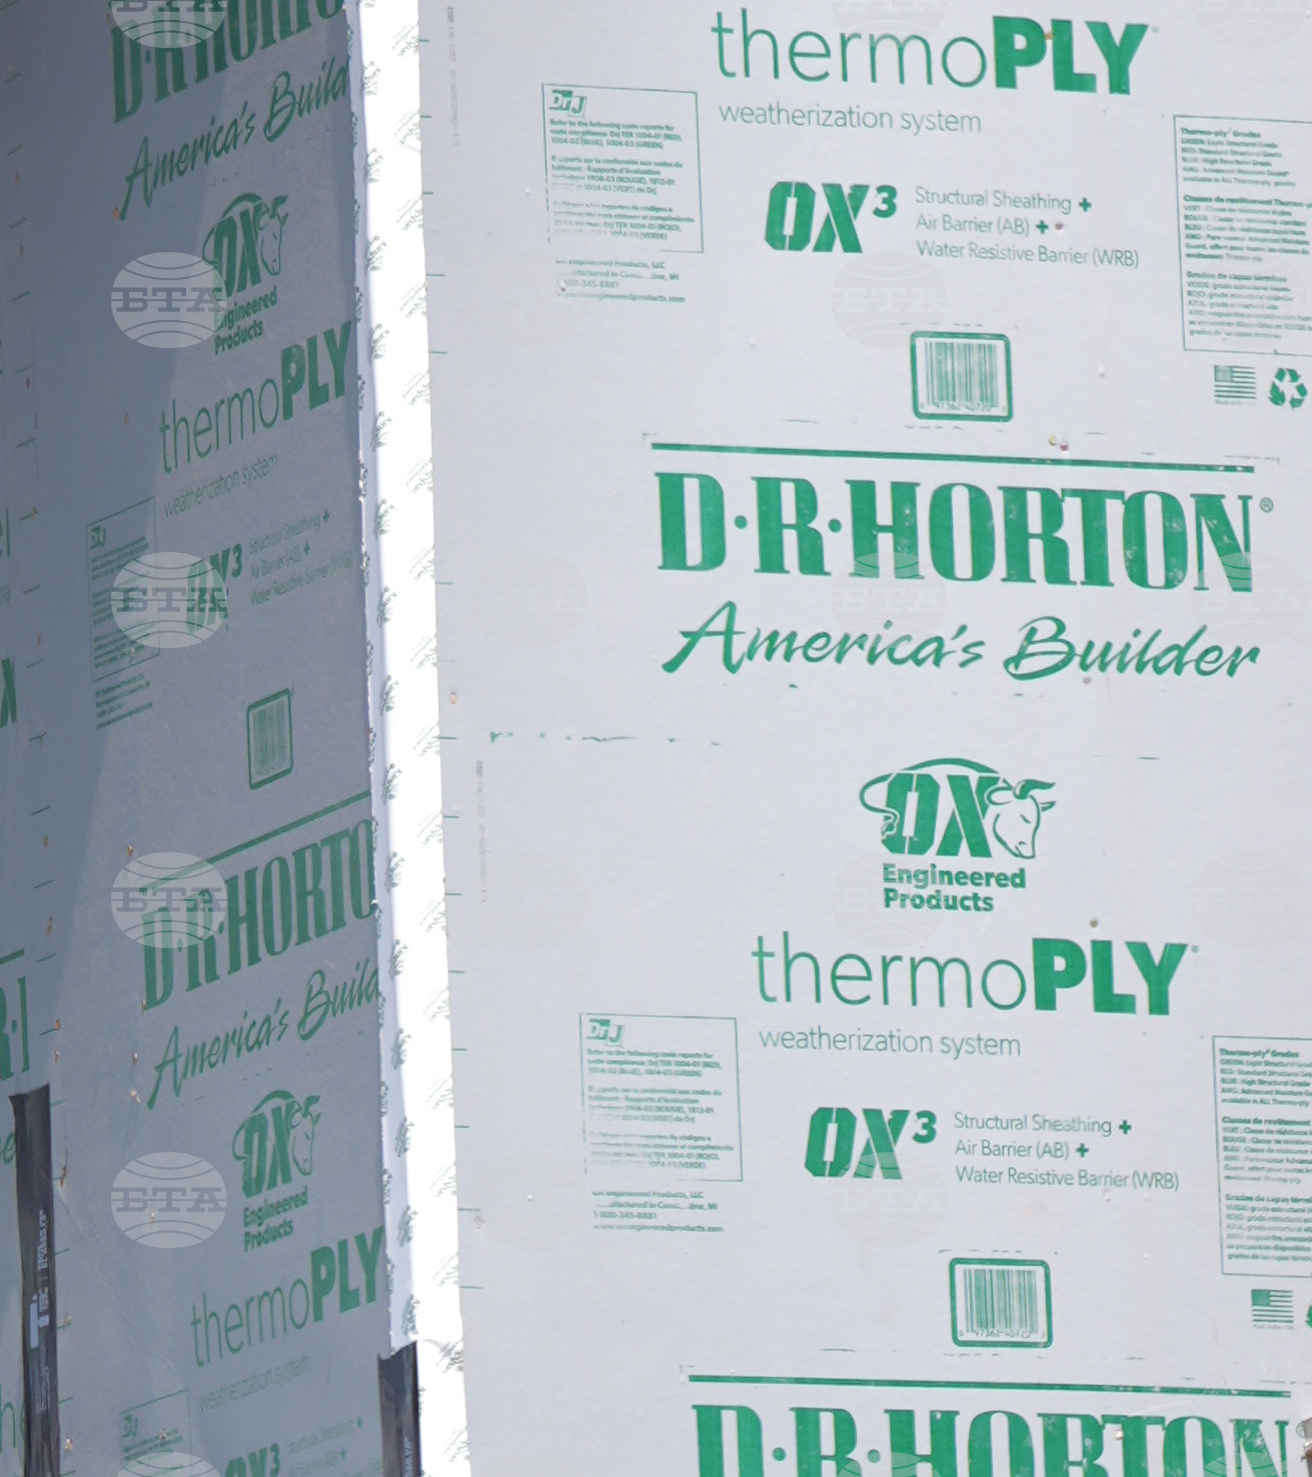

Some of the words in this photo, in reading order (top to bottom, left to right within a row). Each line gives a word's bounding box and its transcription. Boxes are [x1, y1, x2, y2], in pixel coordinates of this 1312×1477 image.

[712, 10, 1148, 96] thermoPLY
[719, 103, 893, 130] weatherization
[900, 111, 983, 138] system
[915, 186, 988, 206] Structural
[993, 190, 1072, 215] Sheathing
[916, 240, 965, 257] Water
[969, 242, 1034, 261] Resistive
[1039, 246, 1089, 264] Barrier
[1093, 247, 1139, 268] (WRB)
[663, 602, 983, 674] America's
[1004, 617, 1259, 682] Builder
[883, 762, 1003, 858] OX
[753, 933, 1187, 1017] thermoPLY
